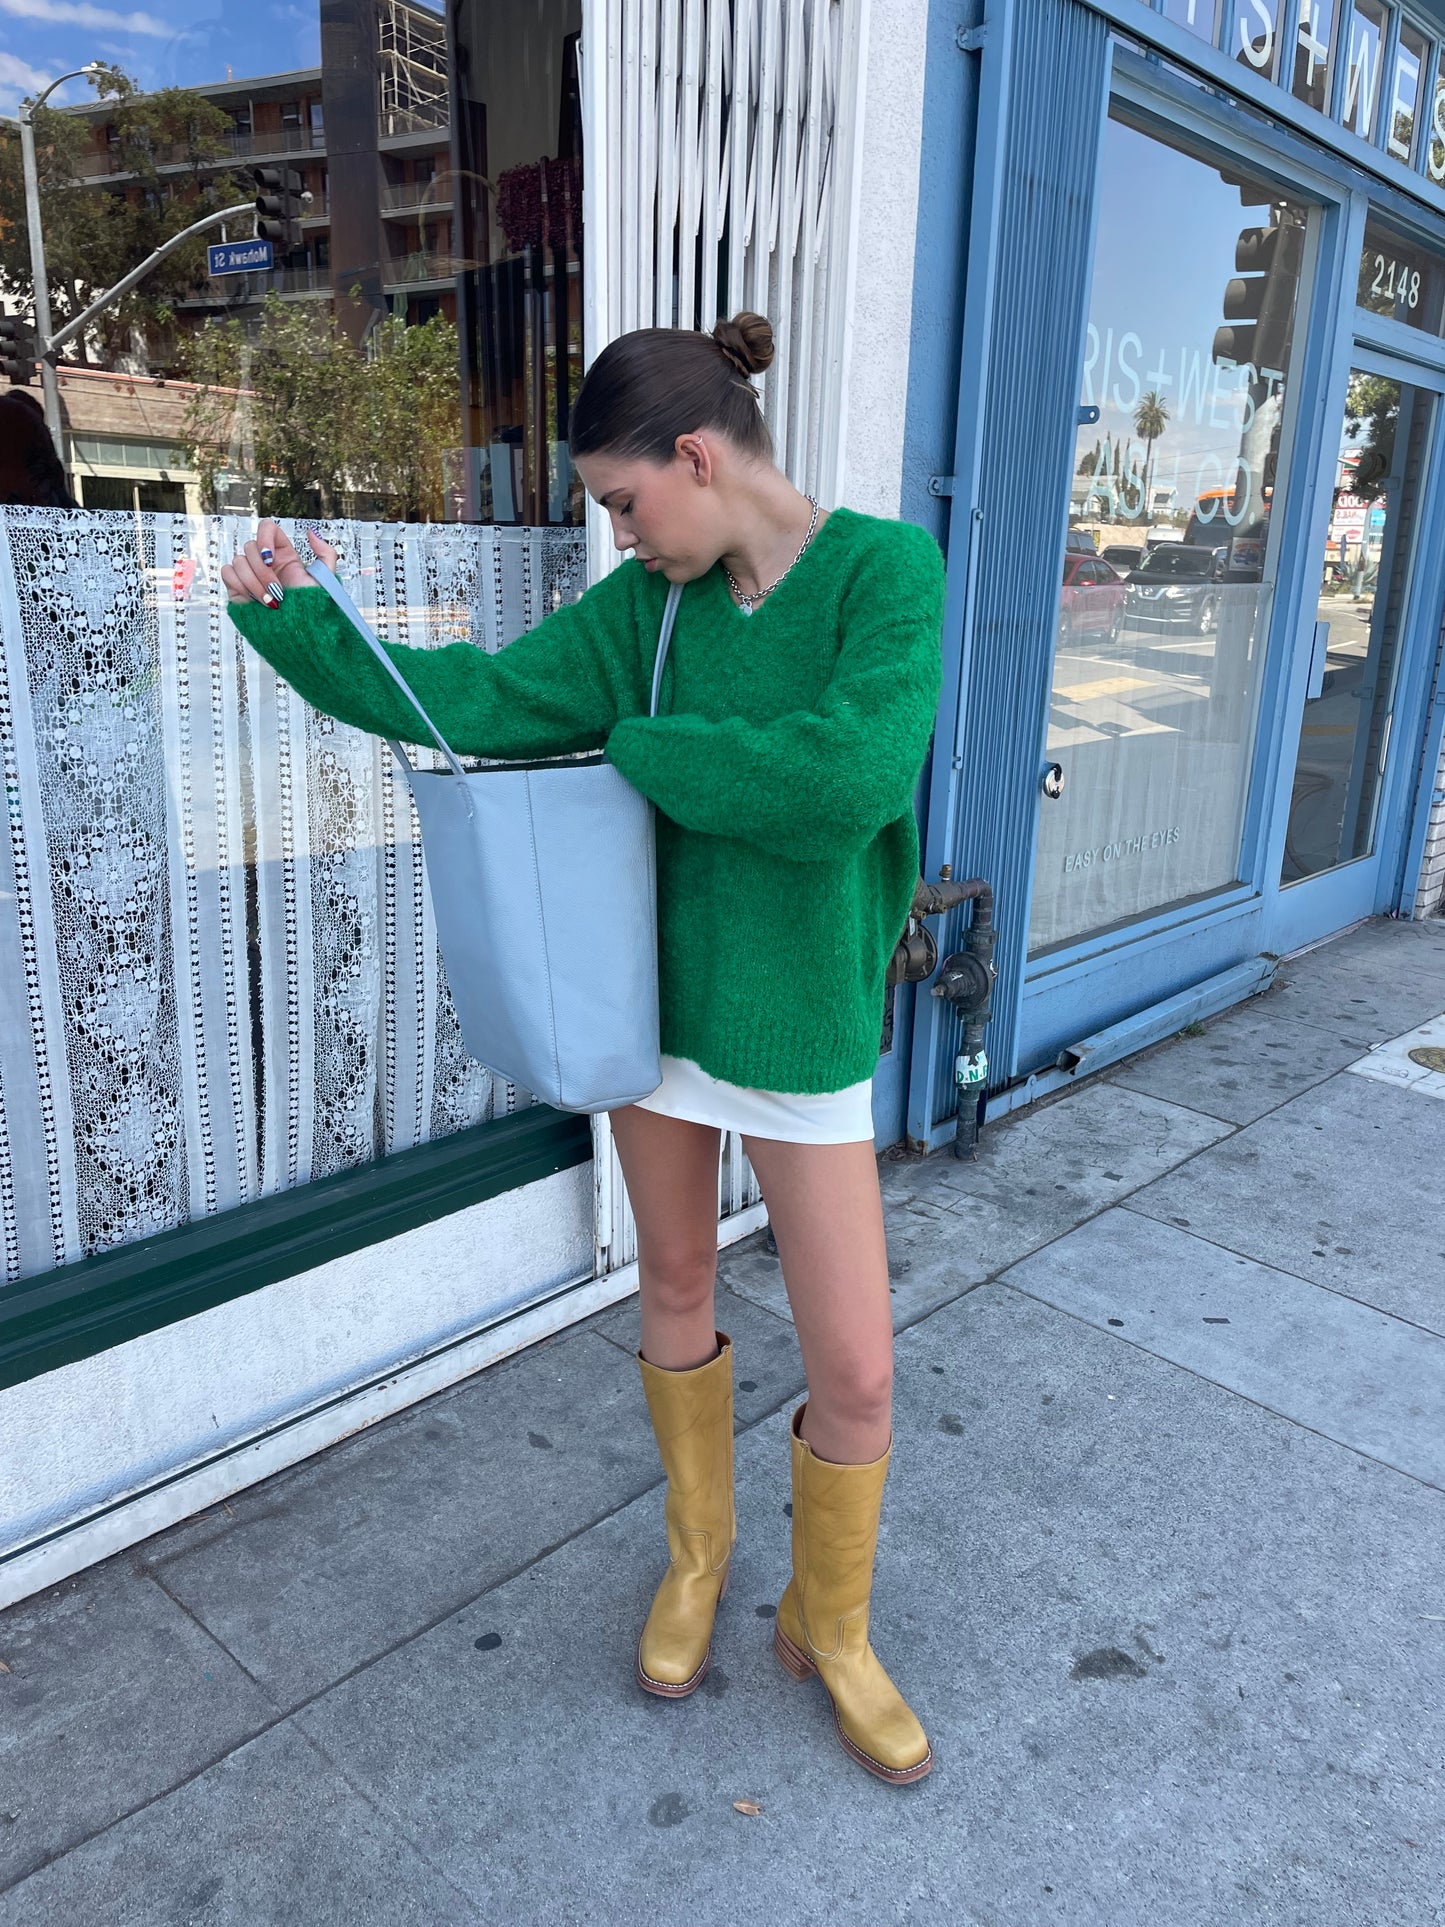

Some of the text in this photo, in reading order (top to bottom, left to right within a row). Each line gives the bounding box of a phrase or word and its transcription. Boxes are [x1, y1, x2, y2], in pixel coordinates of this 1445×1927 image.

[1371, 254, 1421, 309] 2148
[1083, 439, 1256, 527] ASH CO.
[1064, 826, 1181, 873] EASY ON THE EYES
